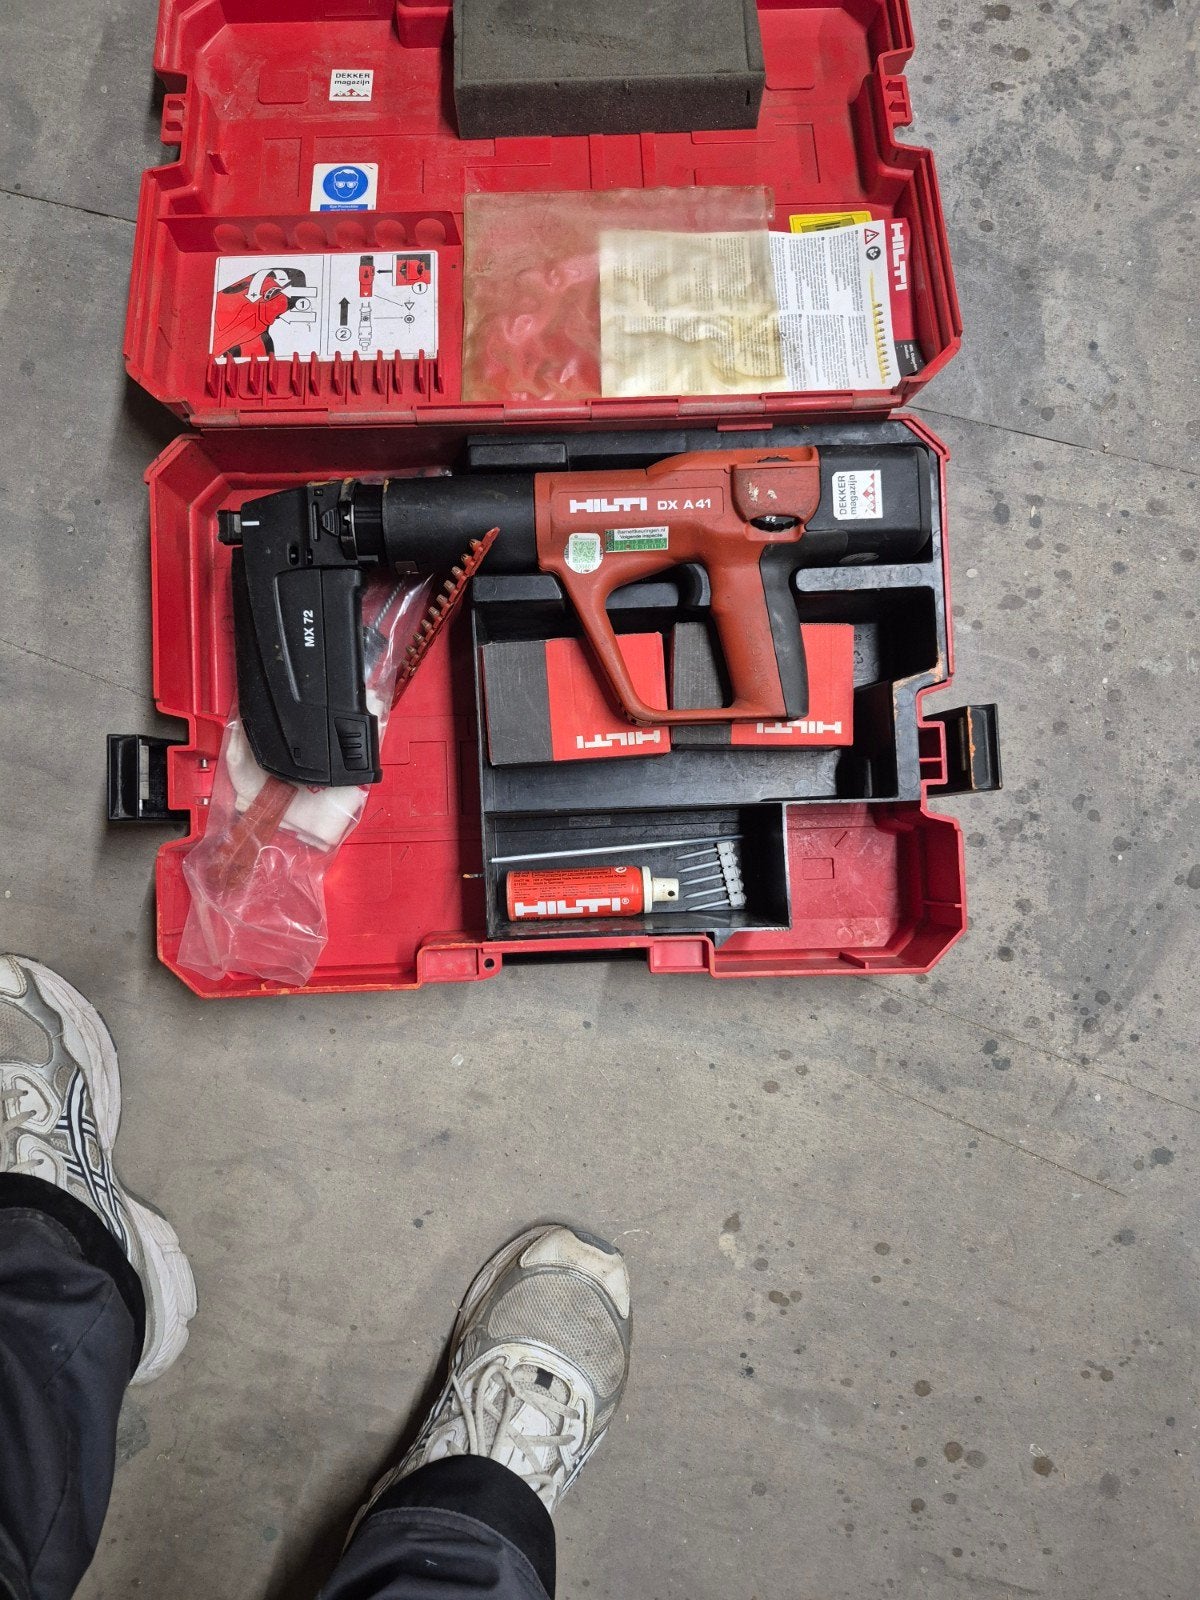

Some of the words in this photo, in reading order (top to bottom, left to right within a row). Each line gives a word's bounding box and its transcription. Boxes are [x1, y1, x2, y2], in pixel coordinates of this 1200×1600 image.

[890, 222, 908, 292] HILTI
[838, 475, 847, 515] DEKKER
[848, 474, 859, 515] magazijn
[569, 497, 648, 514] HILTI
[657, 500, 678, 511] DX
[303, 610, 314, 624] 72
[304, 627, 315, 647] MX
[757, 721, 842, 734] HILTI
[576, 729, 661, 749] HILTI
